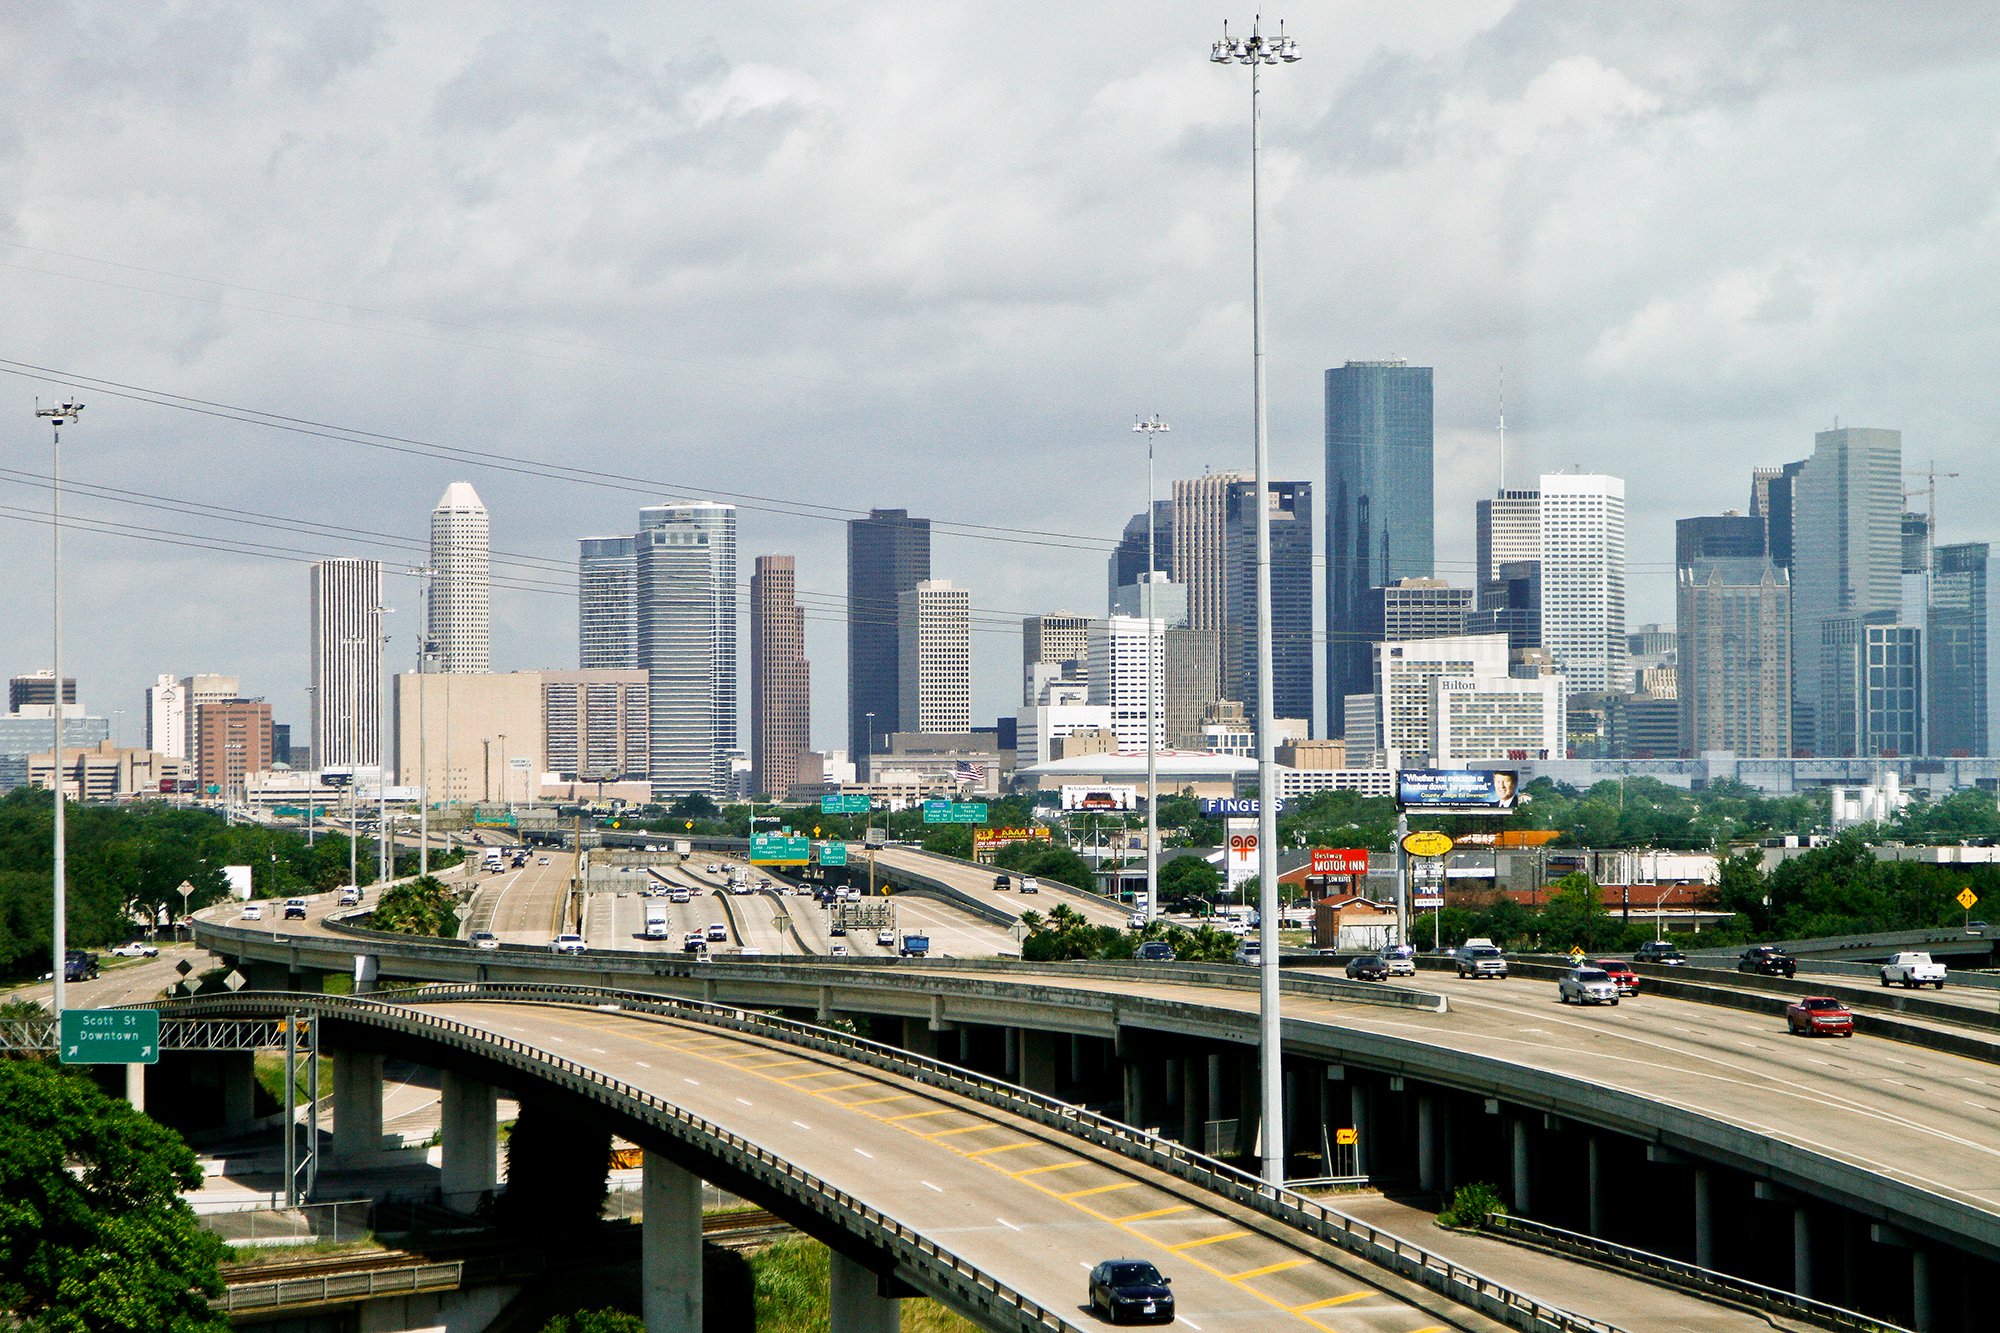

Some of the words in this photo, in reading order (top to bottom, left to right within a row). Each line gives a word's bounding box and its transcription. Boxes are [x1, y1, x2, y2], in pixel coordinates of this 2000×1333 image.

[1442, 680, 1476, 690] Hilton
[1429, 783, 1448, 791] down,
[1459, 783, 1491, 792] prepared."
[1208, 800, 1283, 811] FINGES
[1314, 861, 1346, 871] MOTOR
[1349, 861, 1365, 870] INN
[83, 1016, 113, 1025] Scott
[124, 1016, 136, 1025] St
[80, 1031, 139, 1040] Downtown
